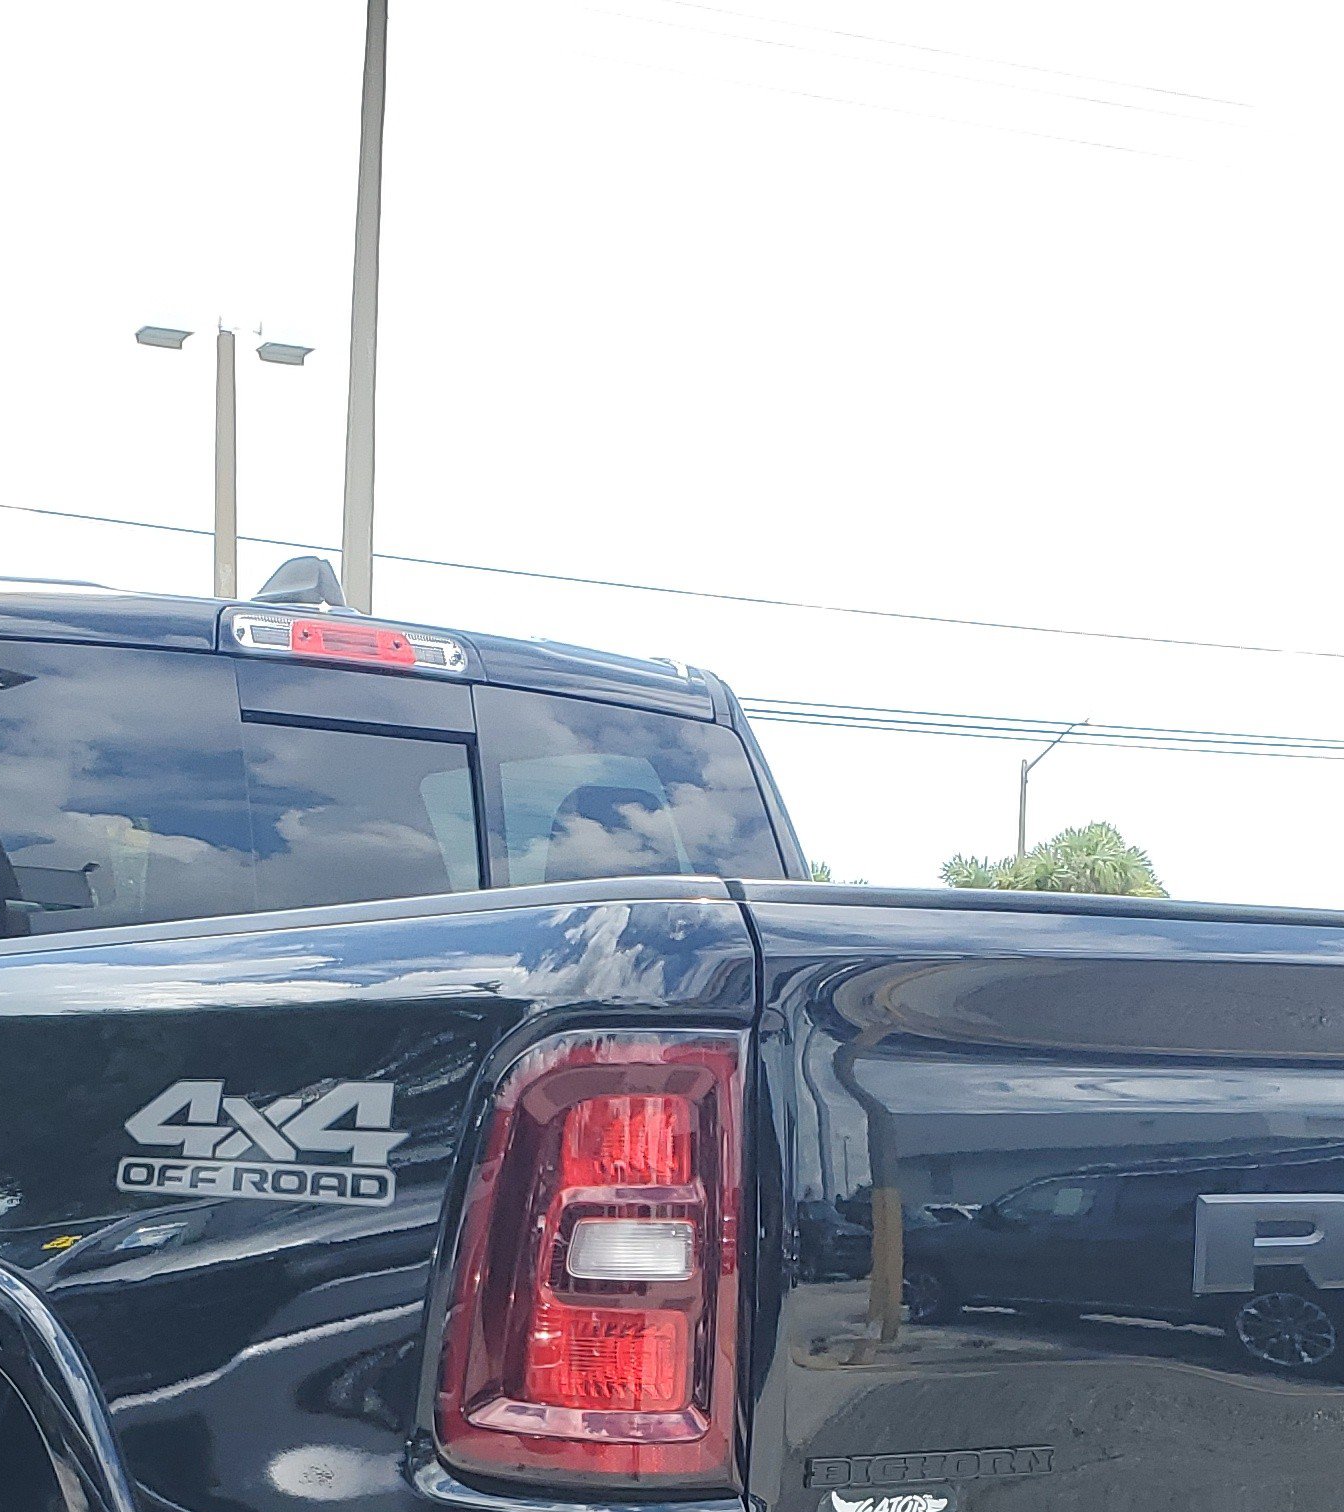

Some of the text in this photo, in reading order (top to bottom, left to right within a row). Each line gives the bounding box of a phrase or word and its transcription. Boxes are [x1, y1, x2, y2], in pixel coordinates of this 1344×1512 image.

[123, 1162, 389, 1199] OFF ROAD
[805, 1445, 1054, 1488] BIGHORN
